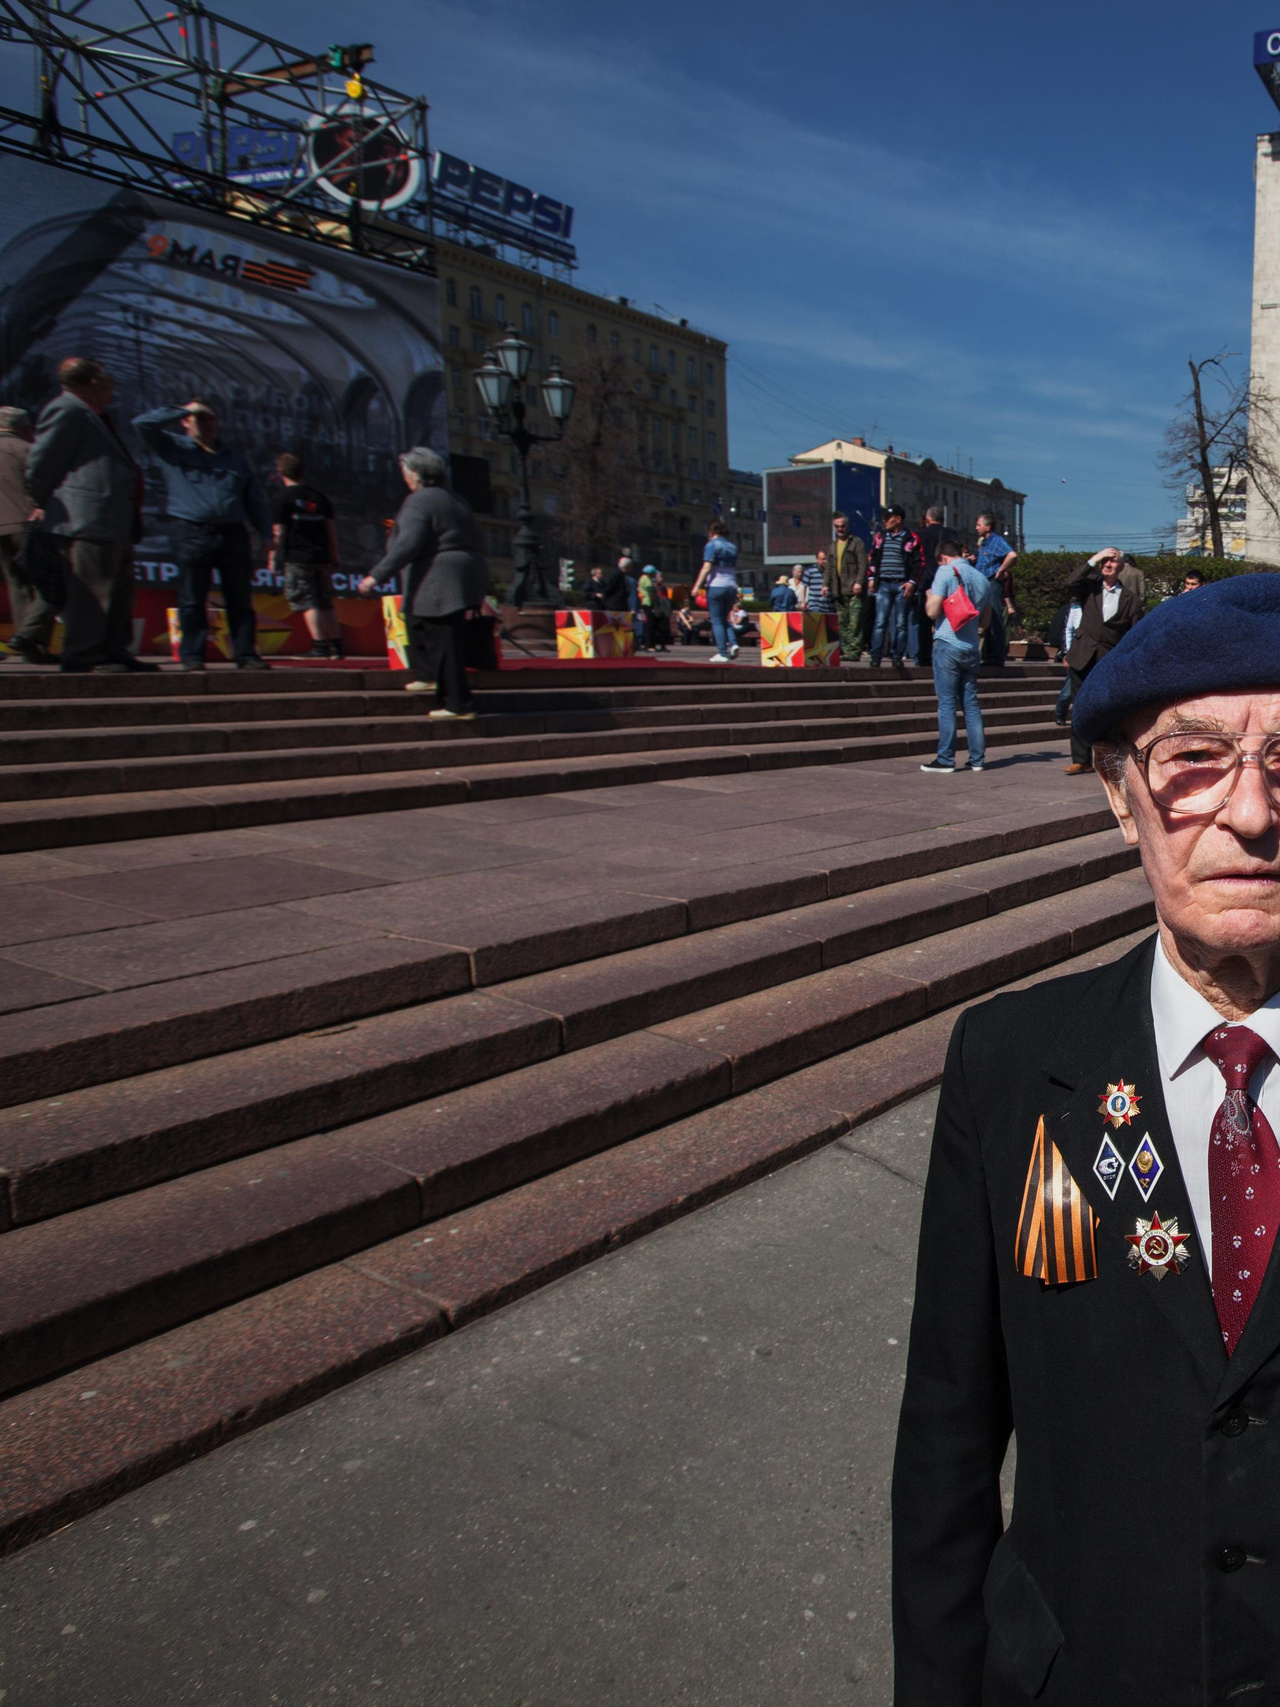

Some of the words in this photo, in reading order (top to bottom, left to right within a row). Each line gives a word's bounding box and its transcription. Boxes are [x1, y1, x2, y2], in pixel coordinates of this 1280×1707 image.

[433, 149, 575, 239] PEPSI
[146, 234, 169, 258] 9
[168, 239, 242, 279] МАЯ
